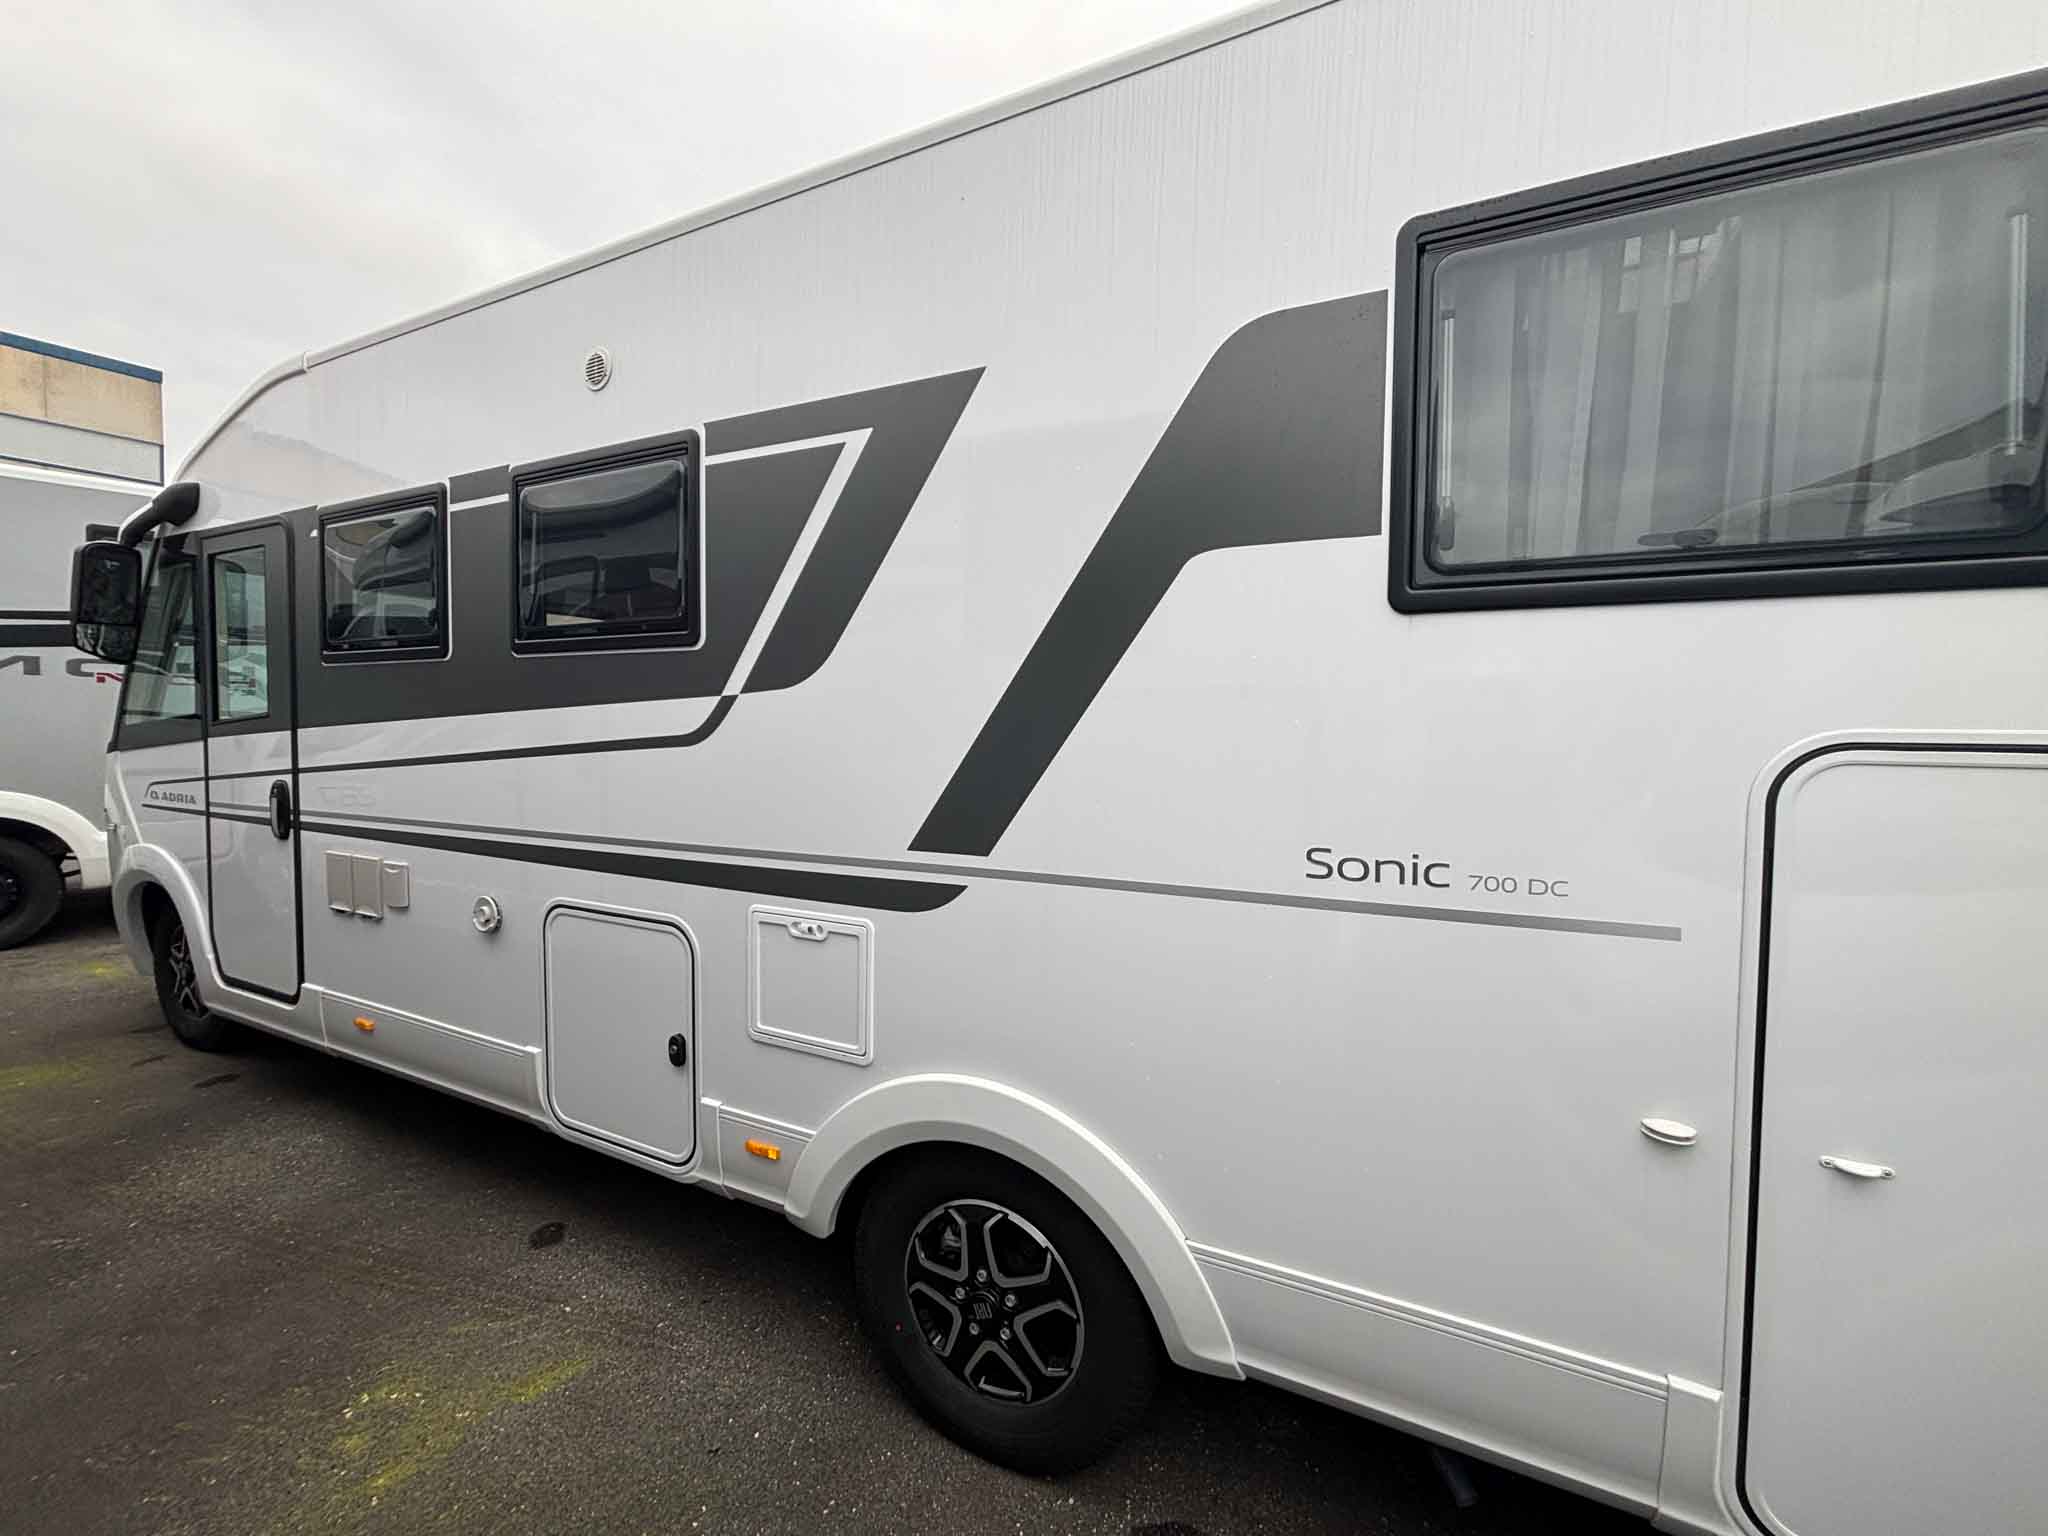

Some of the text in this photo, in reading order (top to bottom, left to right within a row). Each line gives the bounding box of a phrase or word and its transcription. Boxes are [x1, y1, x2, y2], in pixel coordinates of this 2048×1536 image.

[161, 791, 197, 805] ADRIA
[1305, 847, 1569, 898] Sonic 700 DC
